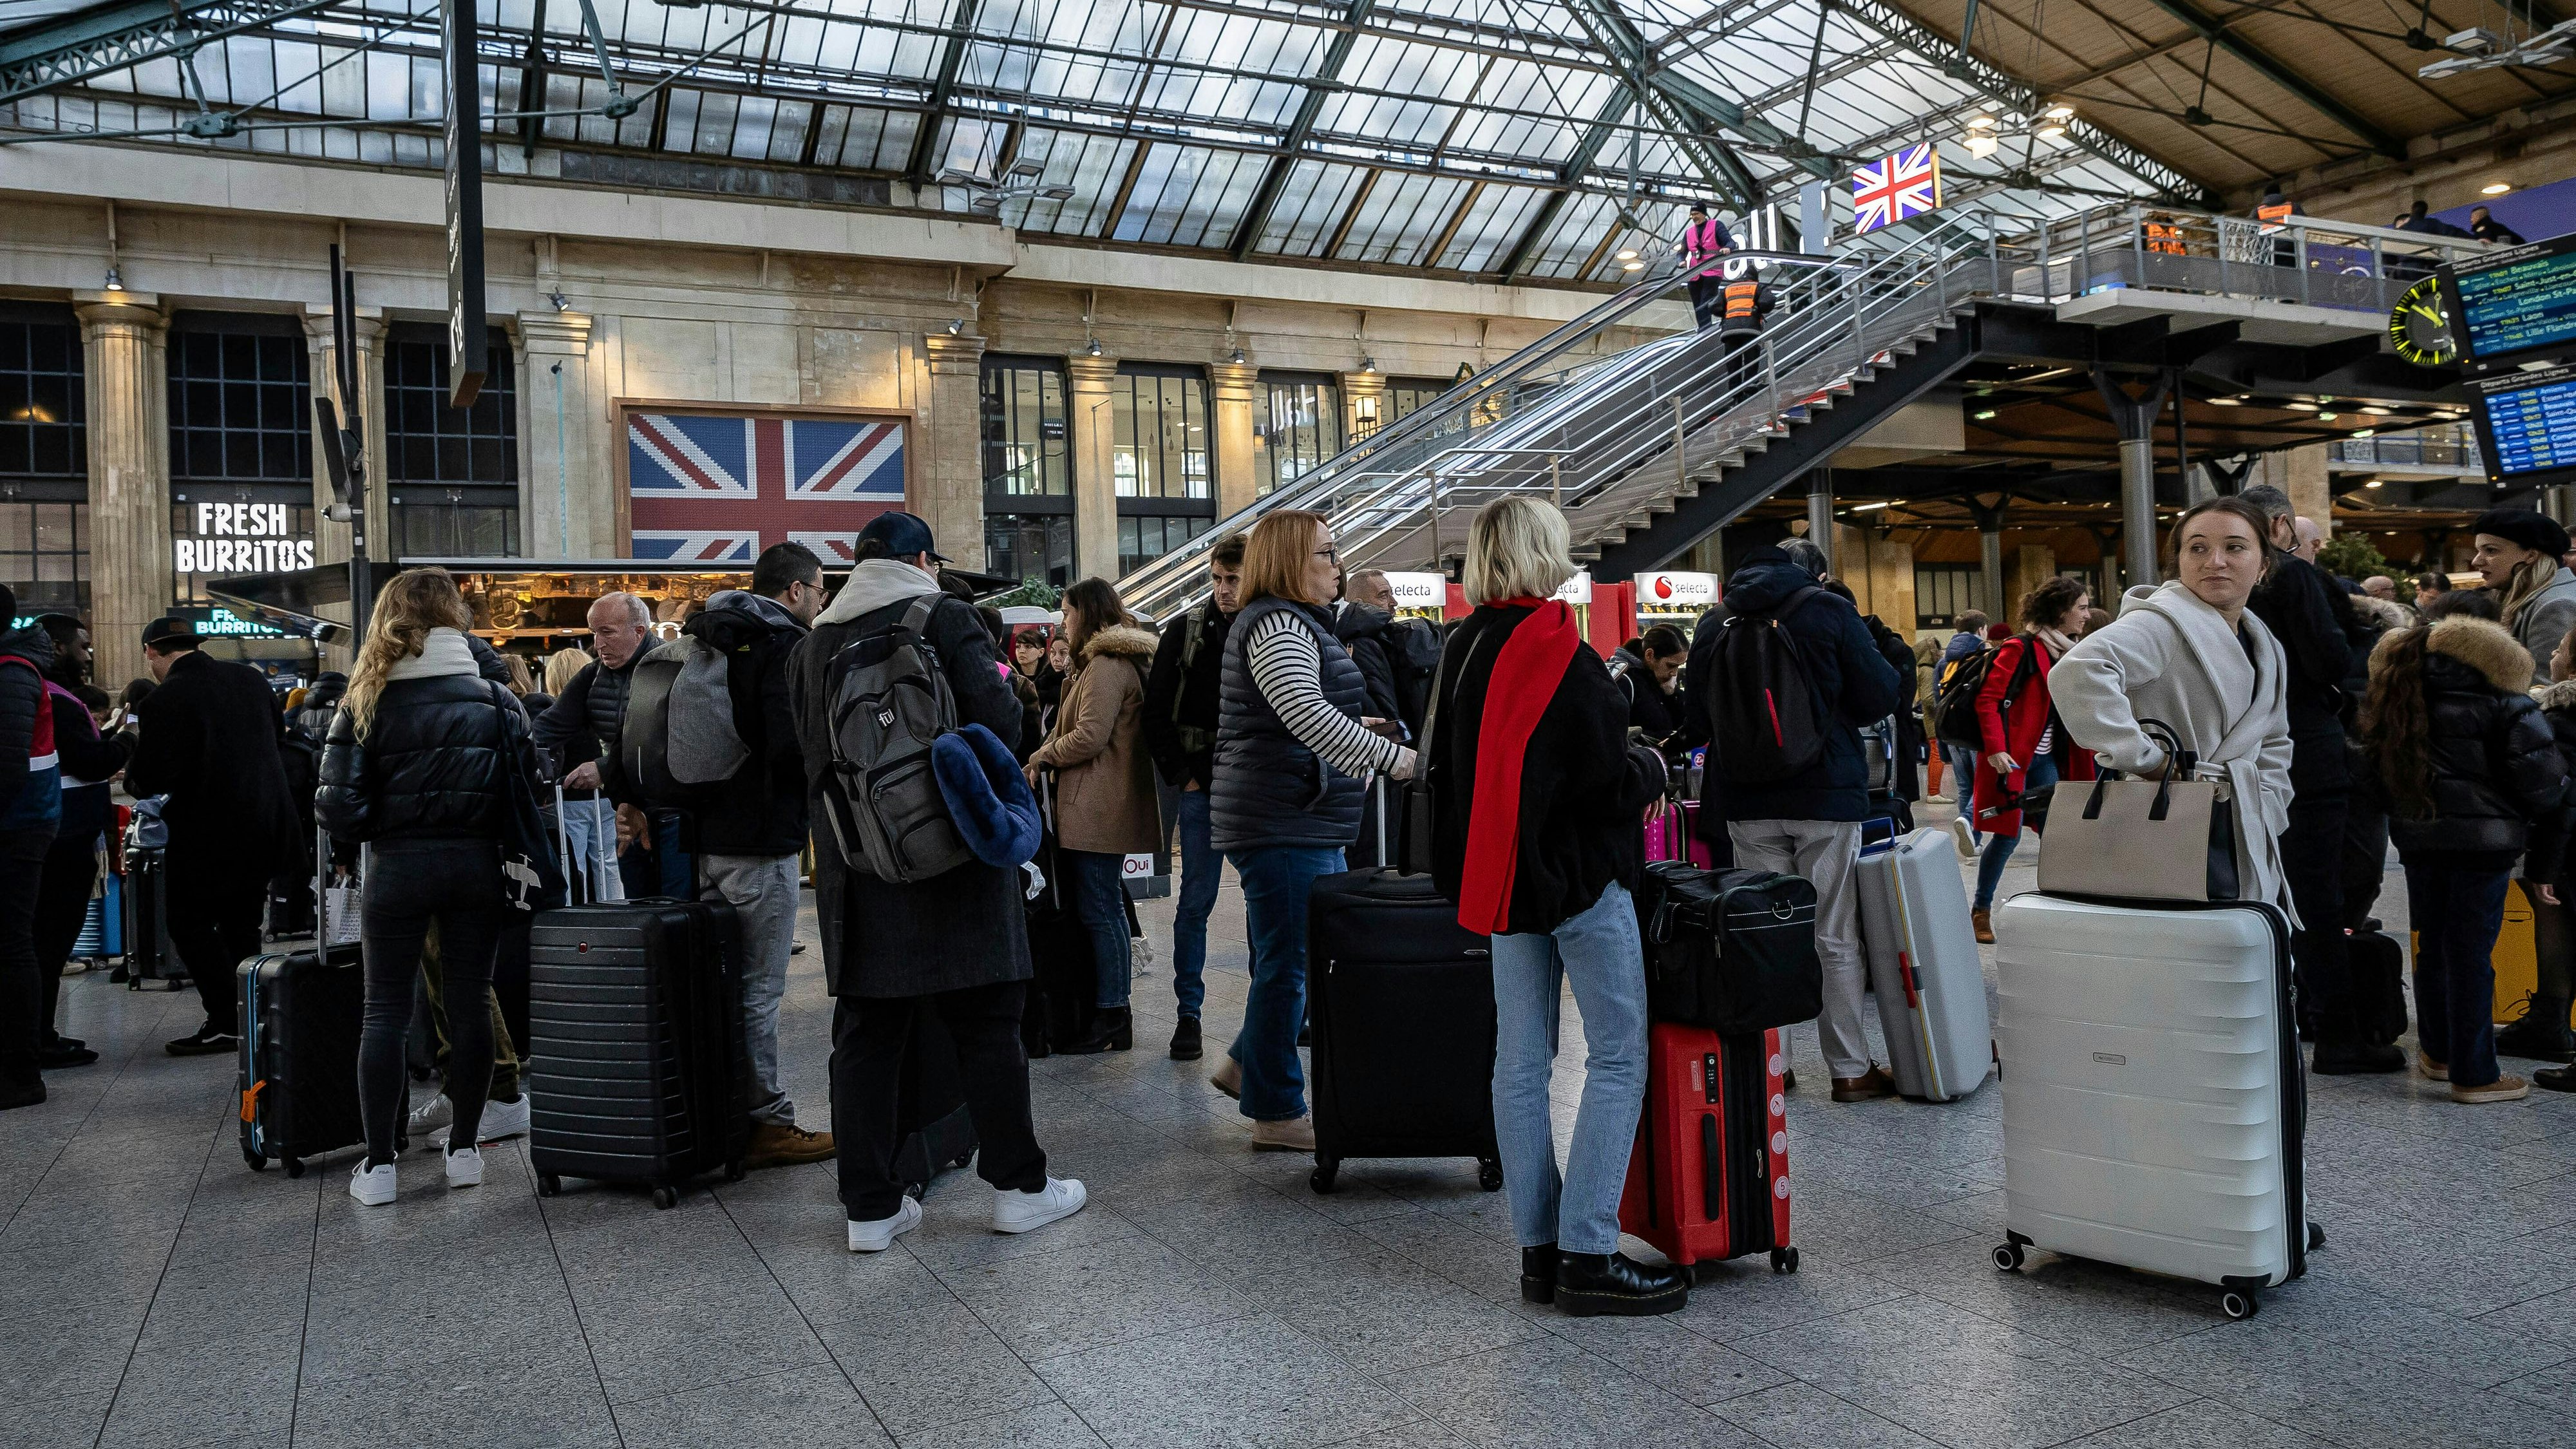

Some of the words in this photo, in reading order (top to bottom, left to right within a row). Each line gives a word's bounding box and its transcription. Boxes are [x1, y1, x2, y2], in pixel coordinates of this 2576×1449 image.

[2483, 252, 2512, 262] Grandes
[2514, 245, 2539, 255] Lignes
[2511, 260, 2549, 274] Beauvais
[2519, 294, 2551, 305] London
[2522, 312, 2544, 321] Laon
[2526, 327, 2544, 337] Lille
[2512, 373, 2543, 383] Grandes
[2544, 368, 2570, 377] Lignes
[198, 503, 287, 535] FRESH
[1676, 583, 1707, 593] selecta
